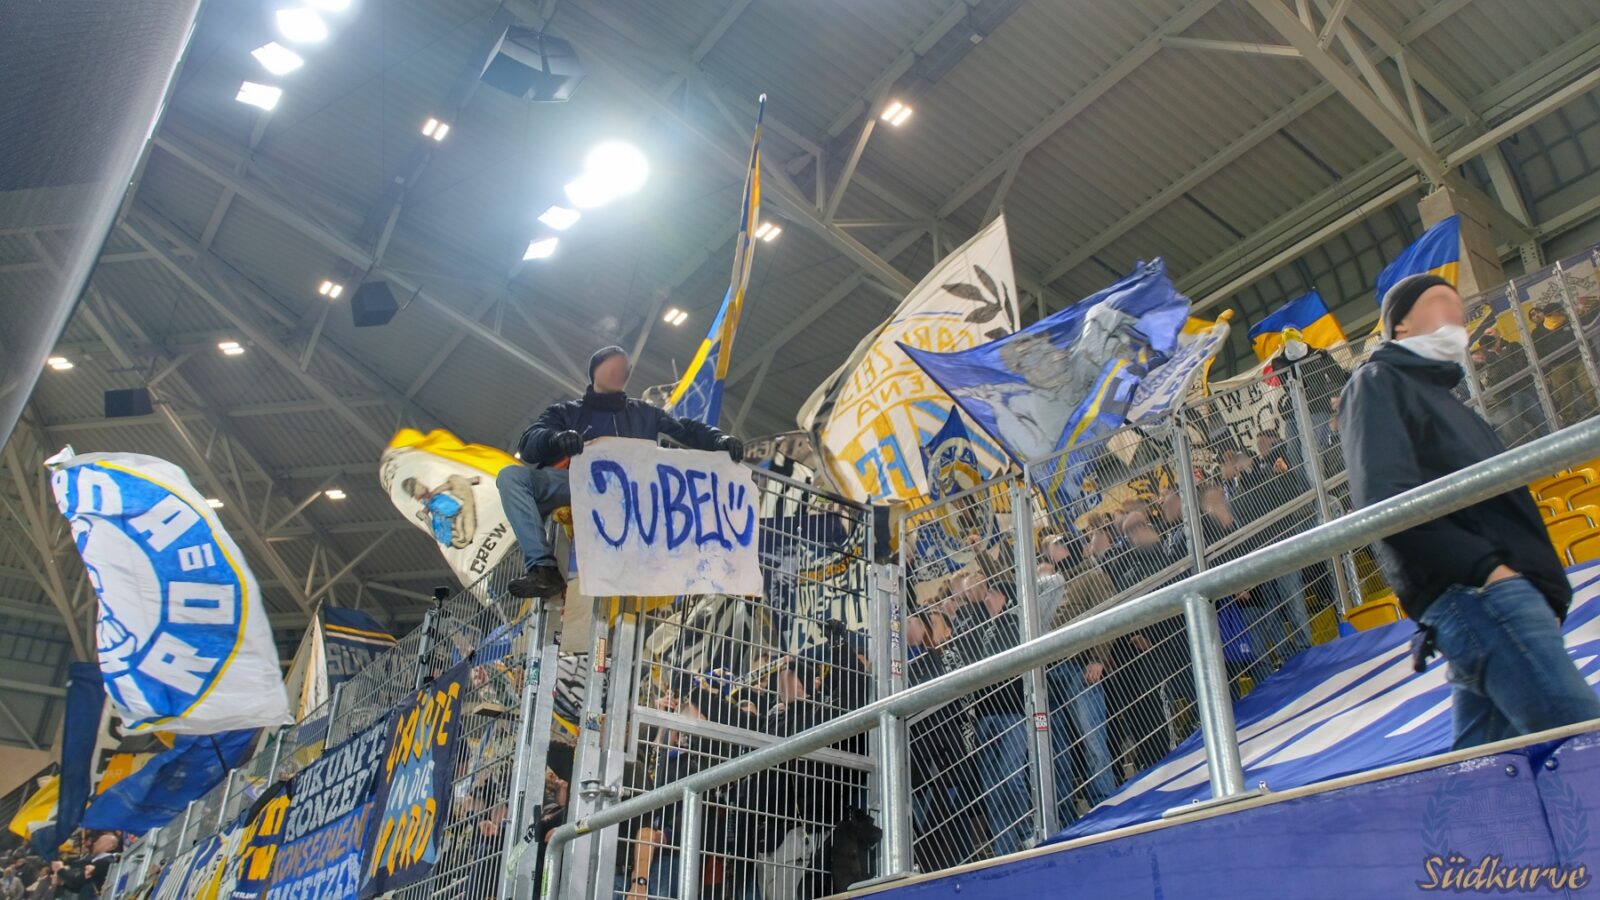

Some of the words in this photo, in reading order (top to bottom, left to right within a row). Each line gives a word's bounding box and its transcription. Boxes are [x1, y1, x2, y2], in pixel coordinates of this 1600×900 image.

[590, 459, 732, 552] JUBEL
[470, 523, 508, 576] CREW
[386, 681, 461, 785] GÄSTE
[408, 759, 435, 805] DIE
